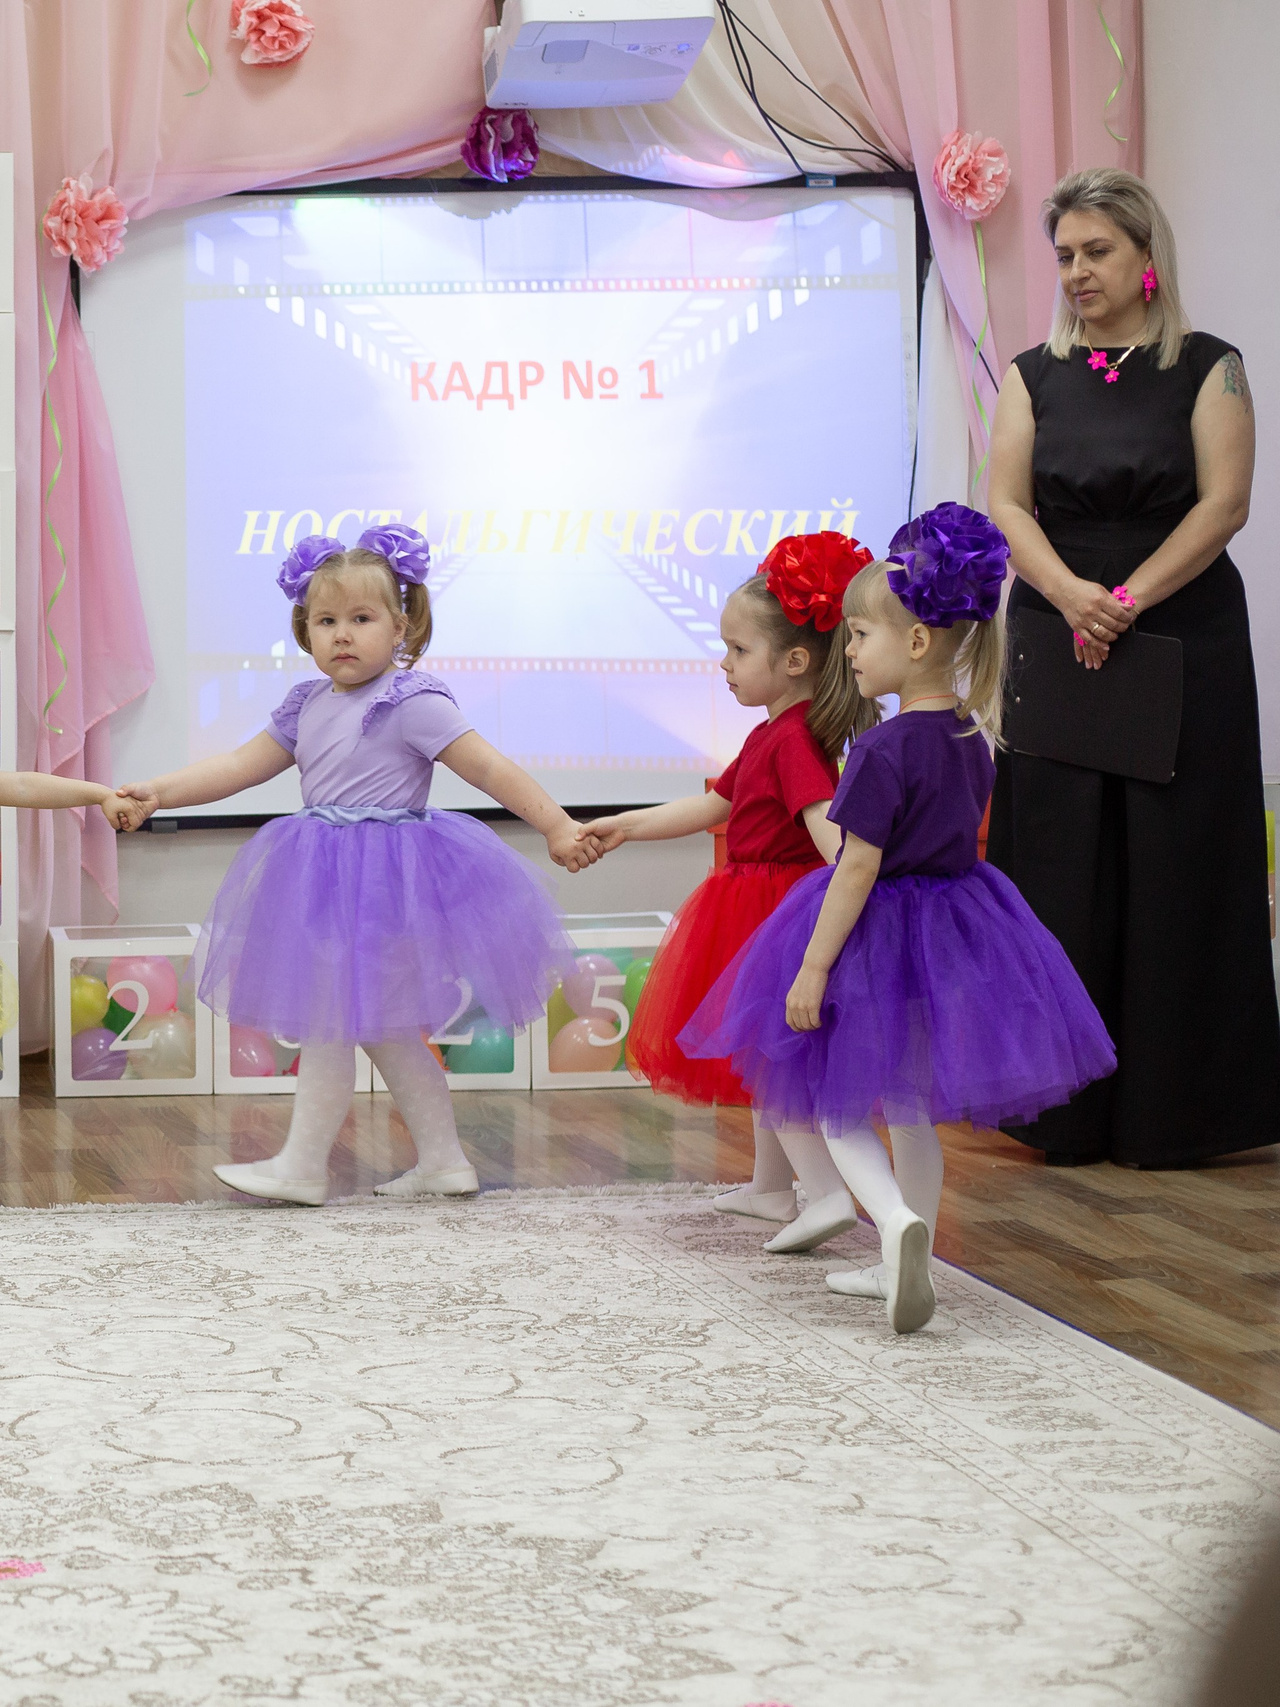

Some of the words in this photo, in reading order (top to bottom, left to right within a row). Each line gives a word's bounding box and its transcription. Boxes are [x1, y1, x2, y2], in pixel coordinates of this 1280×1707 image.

[410, 360, 546, 411] КАДР
[562, 359, 620, 400] №
[638, 359, 664, 399] 1
[106, 979, 154, 1051] 2
[587, 973, 630, 1047] 5
